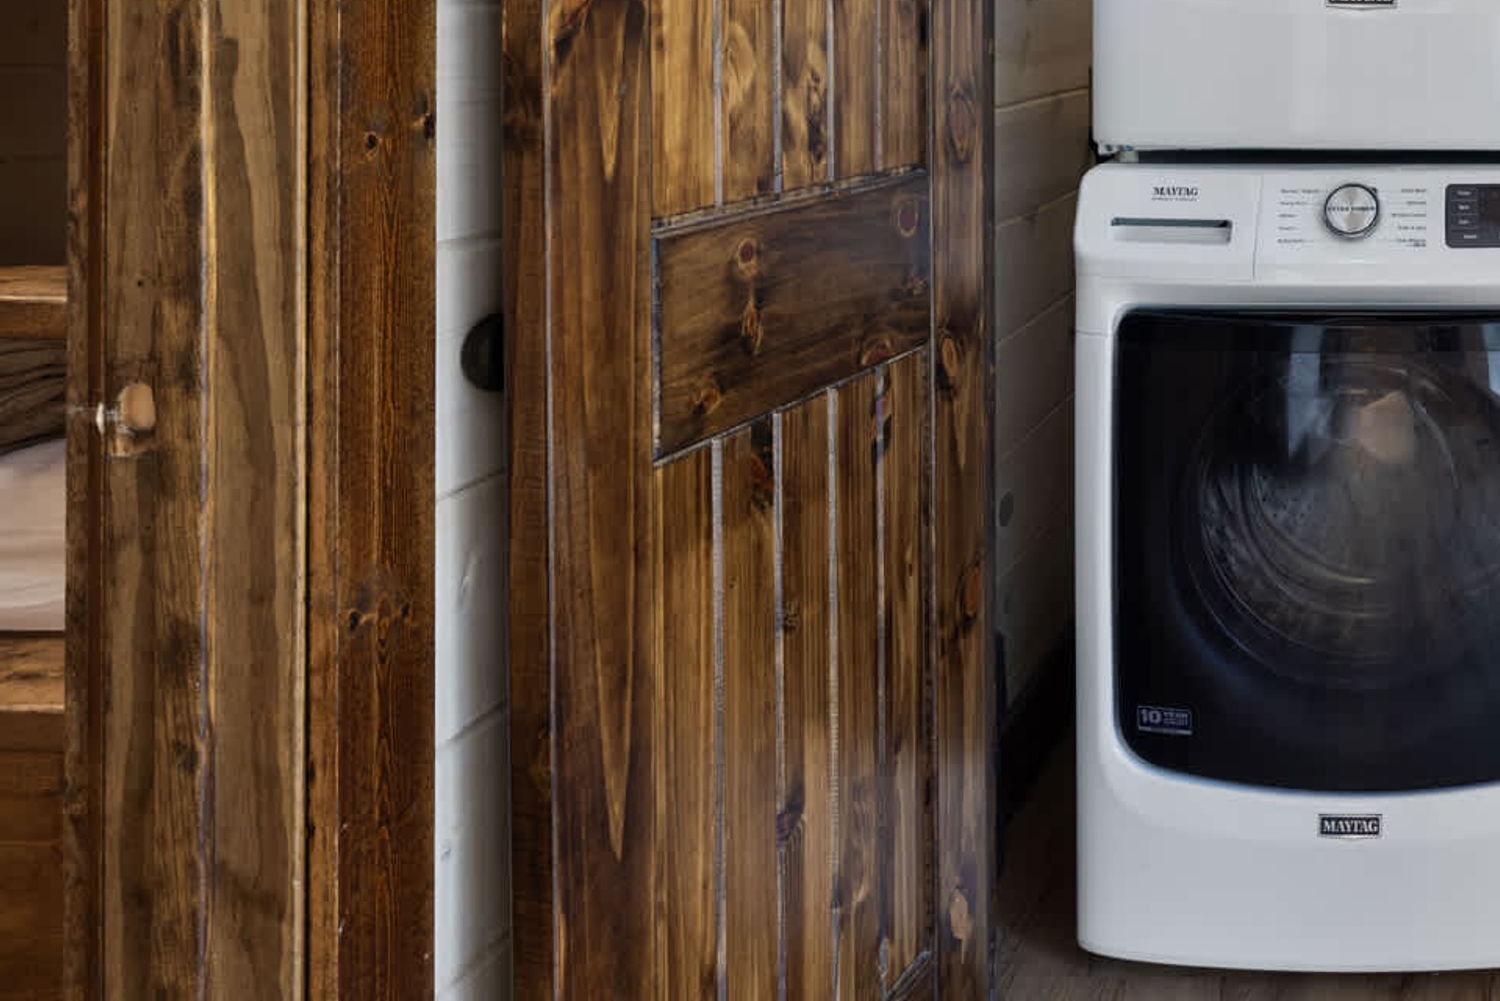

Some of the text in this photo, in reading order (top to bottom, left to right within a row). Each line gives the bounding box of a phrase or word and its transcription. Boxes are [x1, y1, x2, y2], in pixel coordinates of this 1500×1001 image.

[1152, 186, 1199, 196] MAYTAG
[1141, 708, 1161, 725] 10
[1322, 819, 1378, 833] MAYTAG
